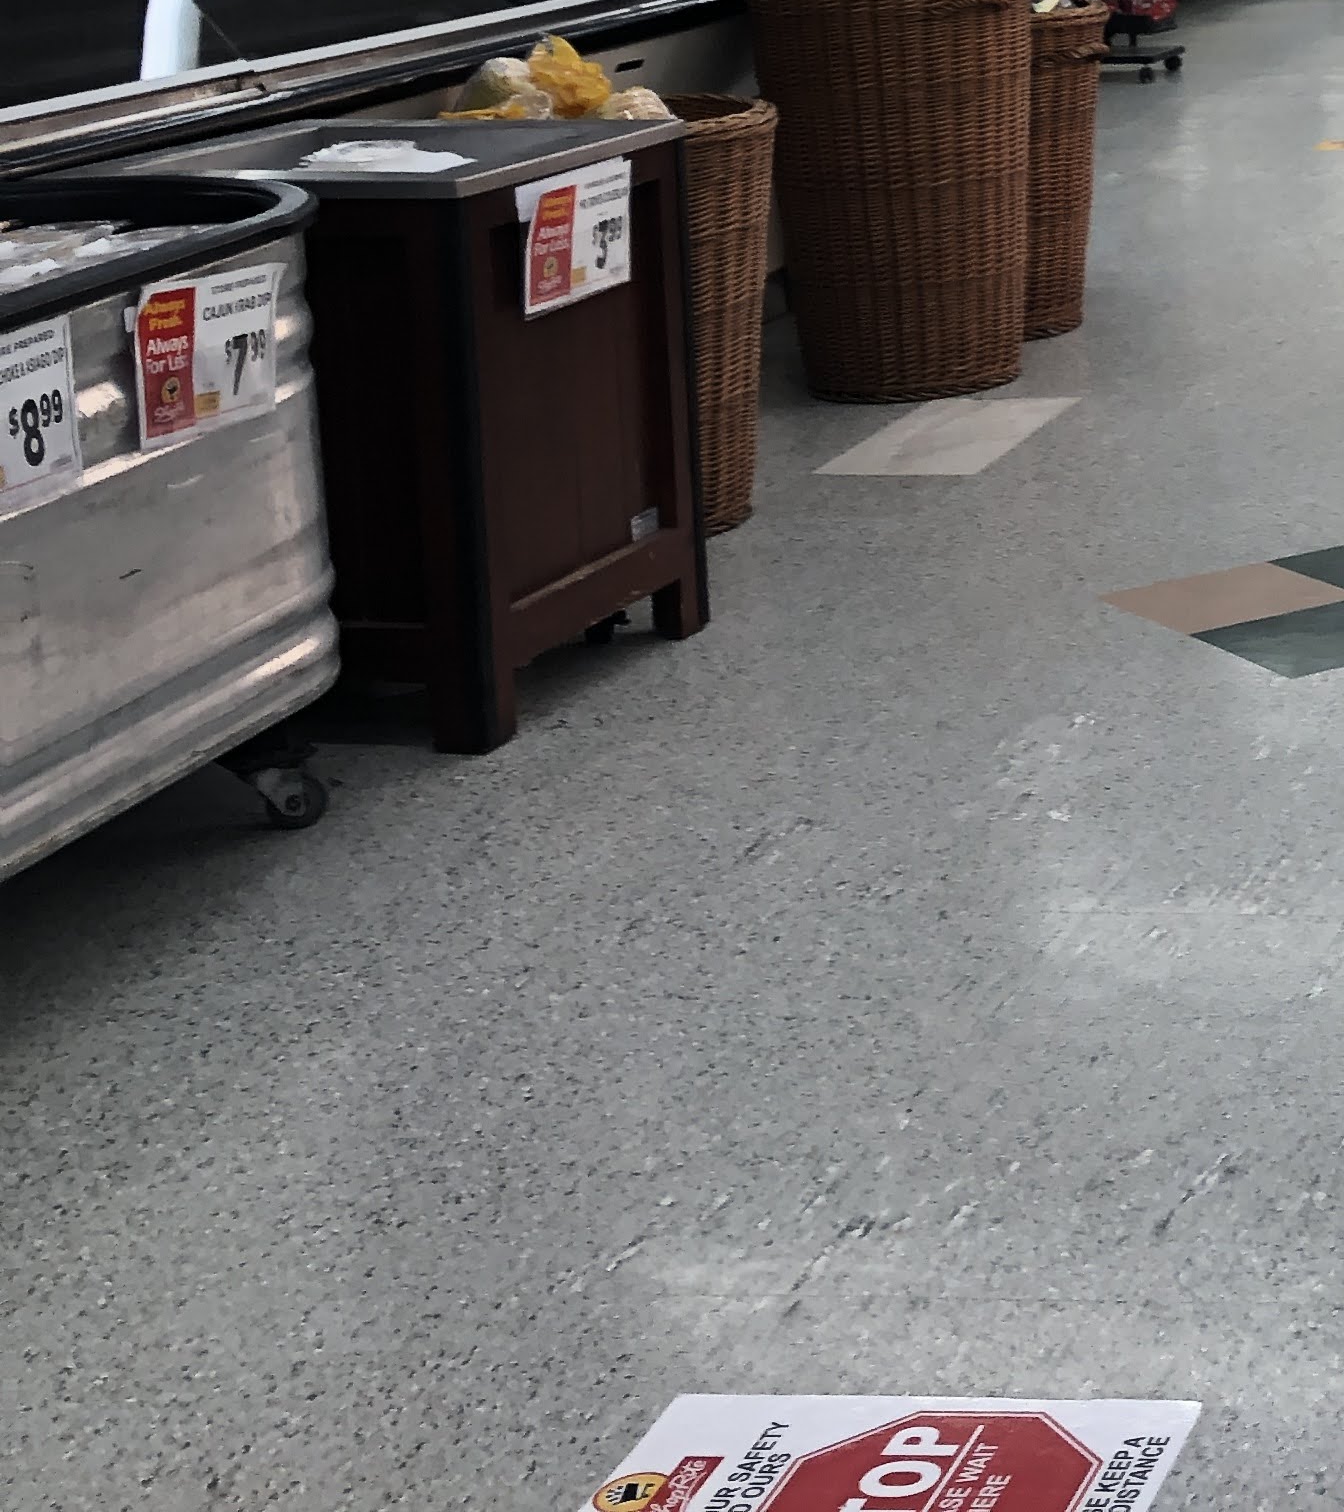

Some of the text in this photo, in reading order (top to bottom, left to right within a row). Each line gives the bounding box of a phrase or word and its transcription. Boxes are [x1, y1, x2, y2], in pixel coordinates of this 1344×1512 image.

[202, 303, 233, 322] CAJUN
[146, 335, 189, 357] Always
[727, 1421, 790, 1482] SAFETY
[956, 1443, 999, 1483] WAIT
[1094, 1450, 1135, 1493] KEEP
[1124, 1436, 1147, 1448] A
[741, 1453, 792, 1498] OURS
[1108, 1437, 1171, 1512] DISTANCE
